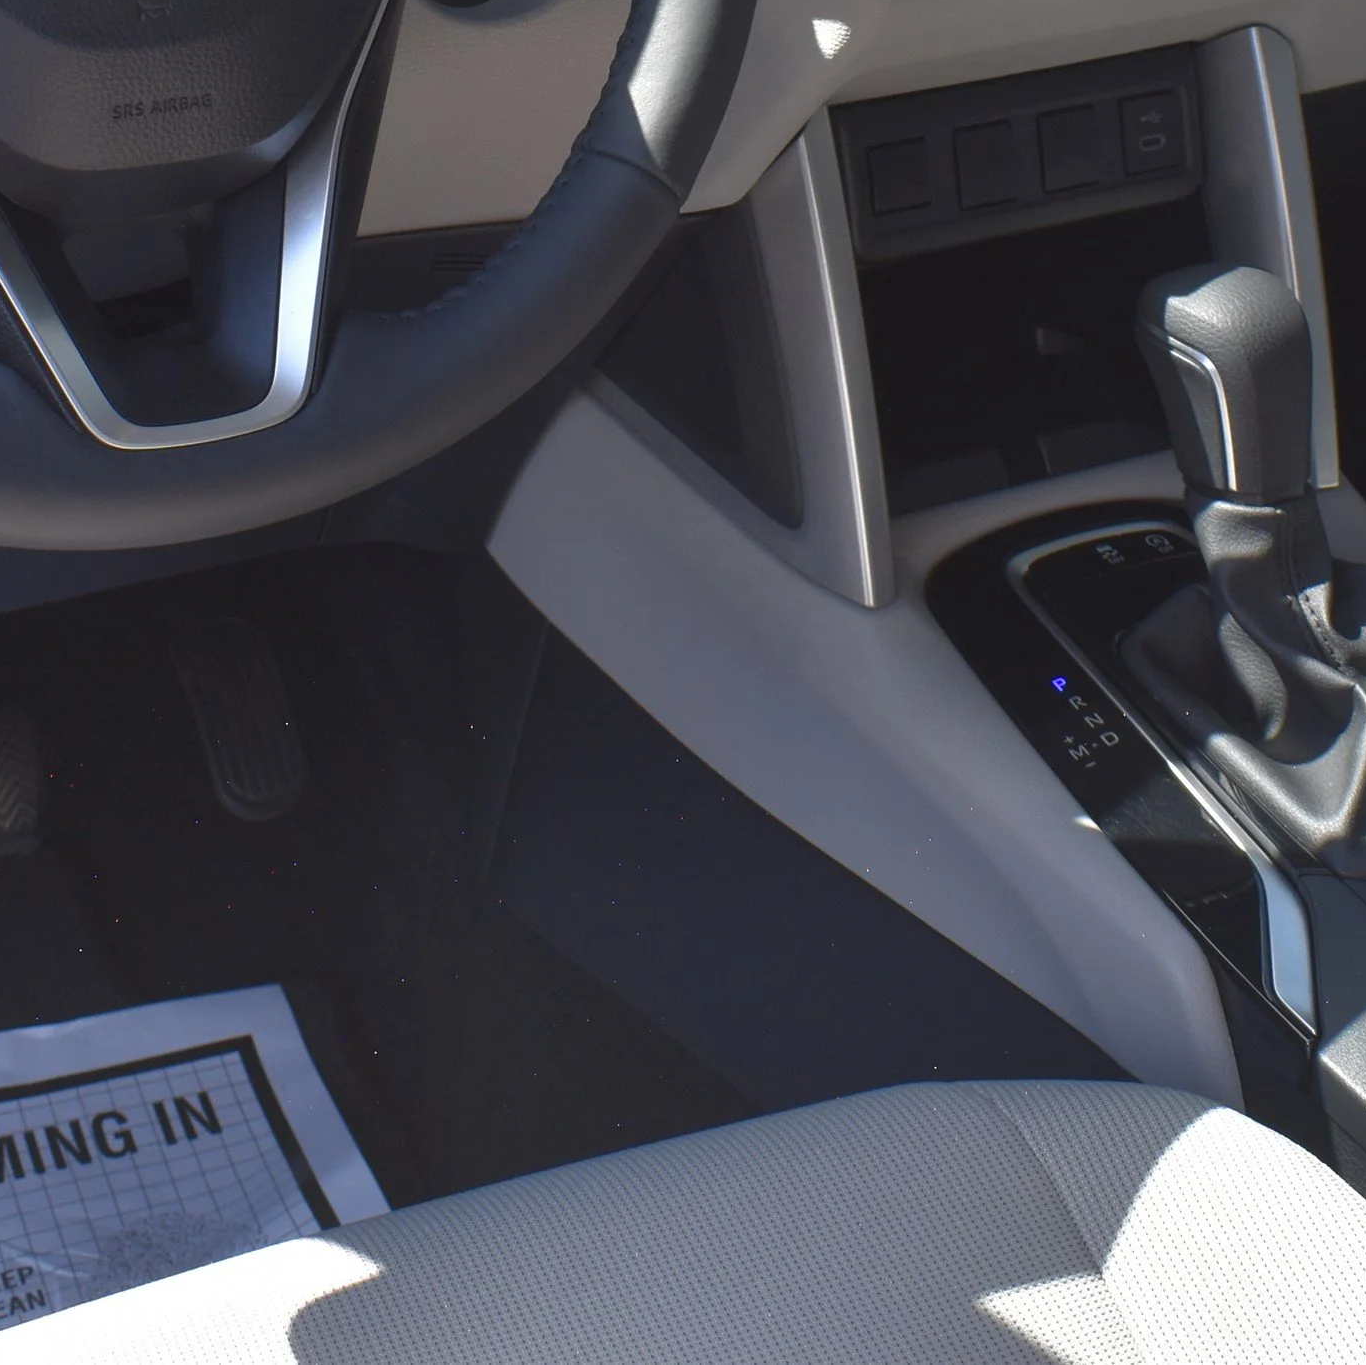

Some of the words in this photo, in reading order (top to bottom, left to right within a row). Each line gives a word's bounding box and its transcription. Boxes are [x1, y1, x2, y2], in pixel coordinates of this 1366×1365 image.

[112, 101, 144, 120] SRS
[150, 93, 212, 115] AIRBAG
[1051, 676, 1067, 692] P
[1067, 695, 1087, 711] R
[1083, 711, 1104, 729] N
[1099, 731, 1120, 748] D
[1067, 742, 1091, 761] M
[152, 1091, 225, 1148] IN
